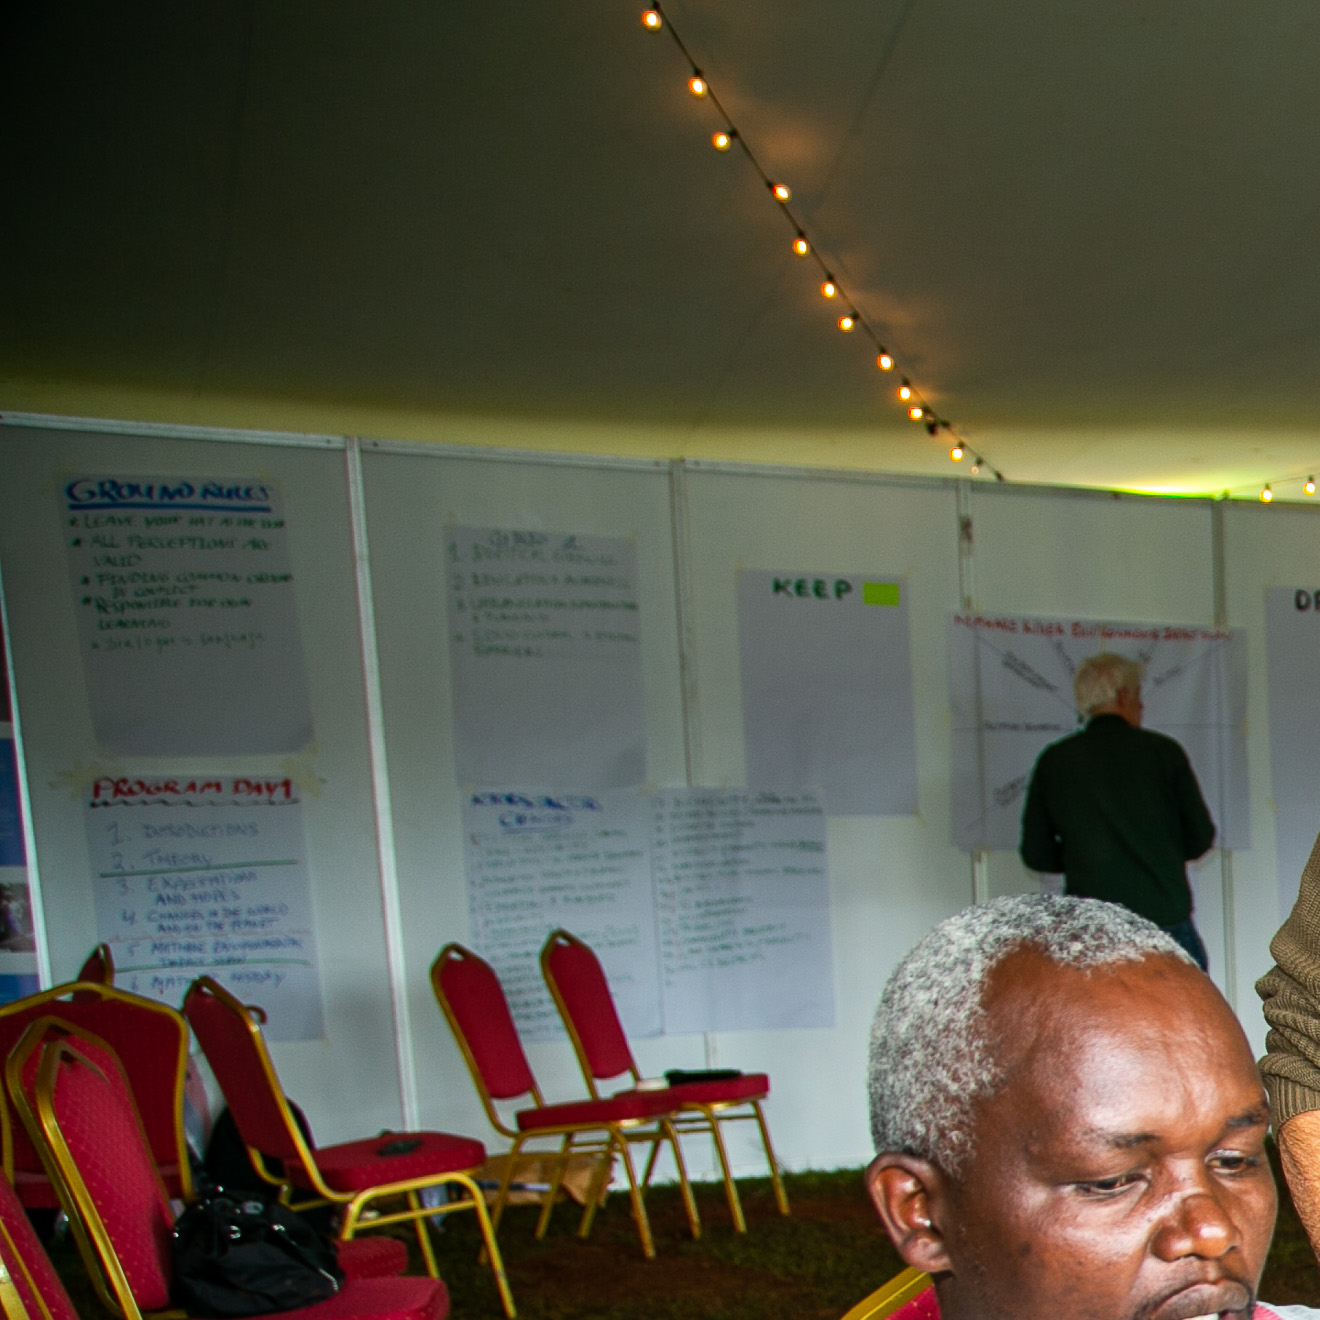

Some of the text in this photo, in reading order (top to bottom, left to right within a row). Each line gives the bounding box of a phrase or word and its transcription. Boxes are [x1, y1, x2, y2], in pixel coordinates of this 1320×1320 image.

[65, 478, 196, 501] GROUND
[771, 576, 855, 600] KEEP
[92, 776, 223, 799] PROGRAM
